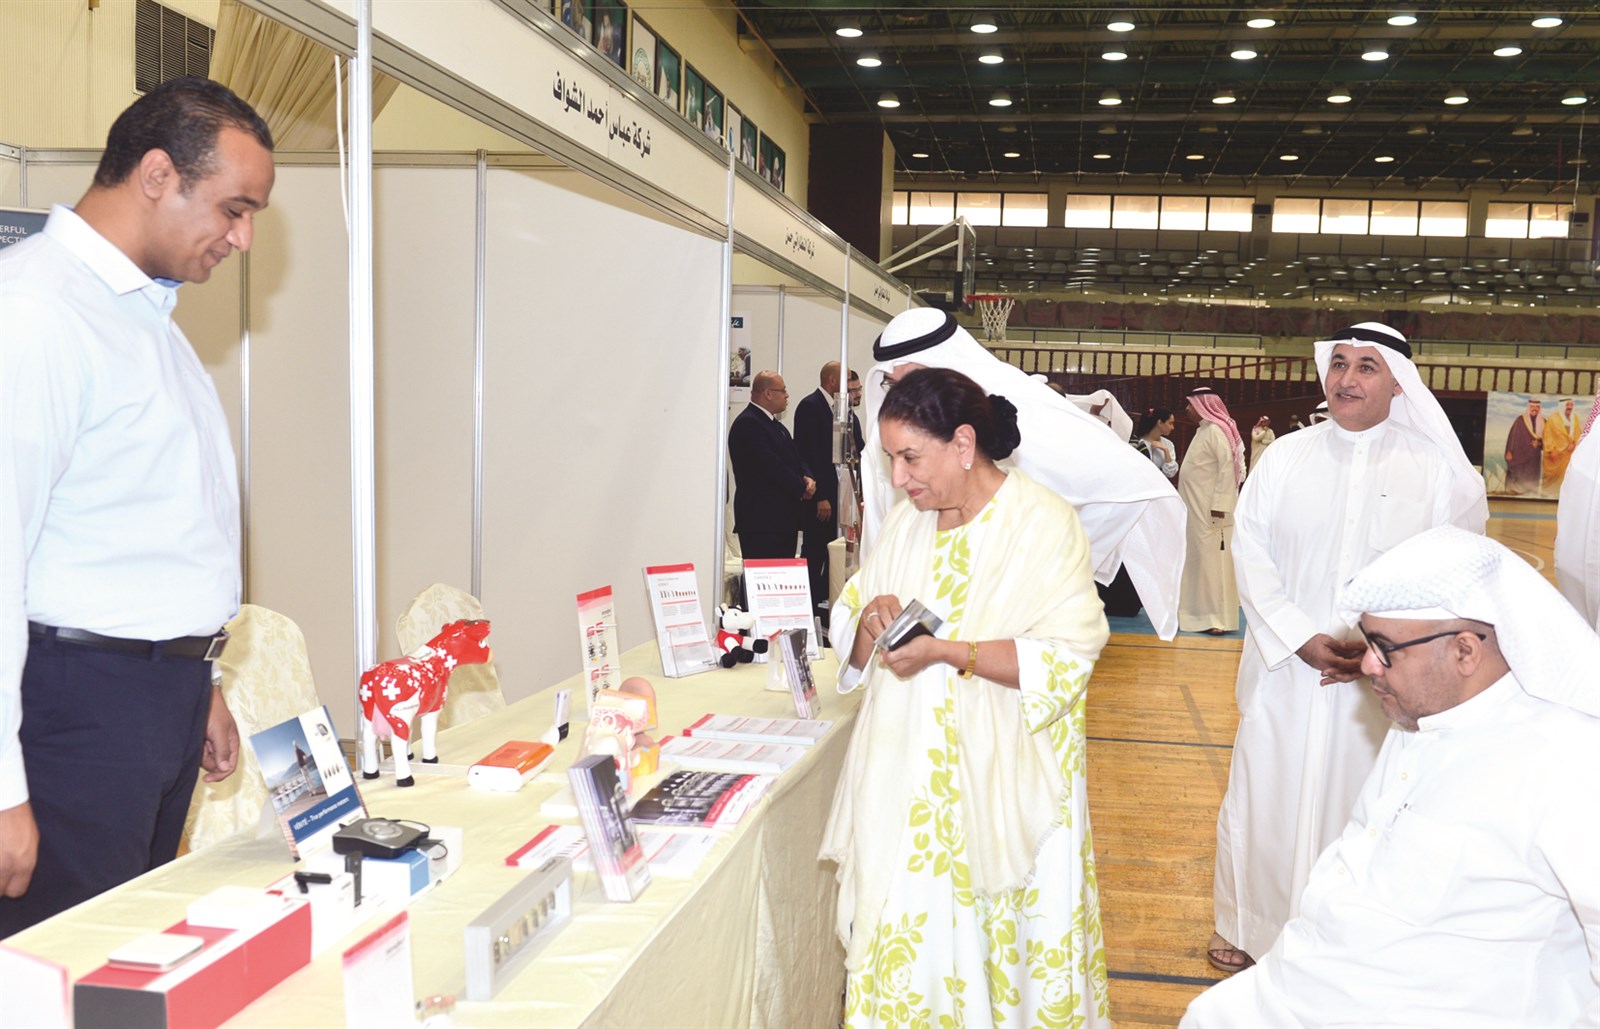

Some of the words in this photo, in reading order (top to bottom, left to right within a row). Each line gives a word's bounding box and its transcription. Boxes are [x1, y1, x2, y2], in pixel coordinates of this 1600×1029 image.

[553, 70, 585, 114] الشواف
[587, 98, 608, 127] أحمد
[609, 115, 631, 147] عباس
[632, 120, 651, 158] شركة
